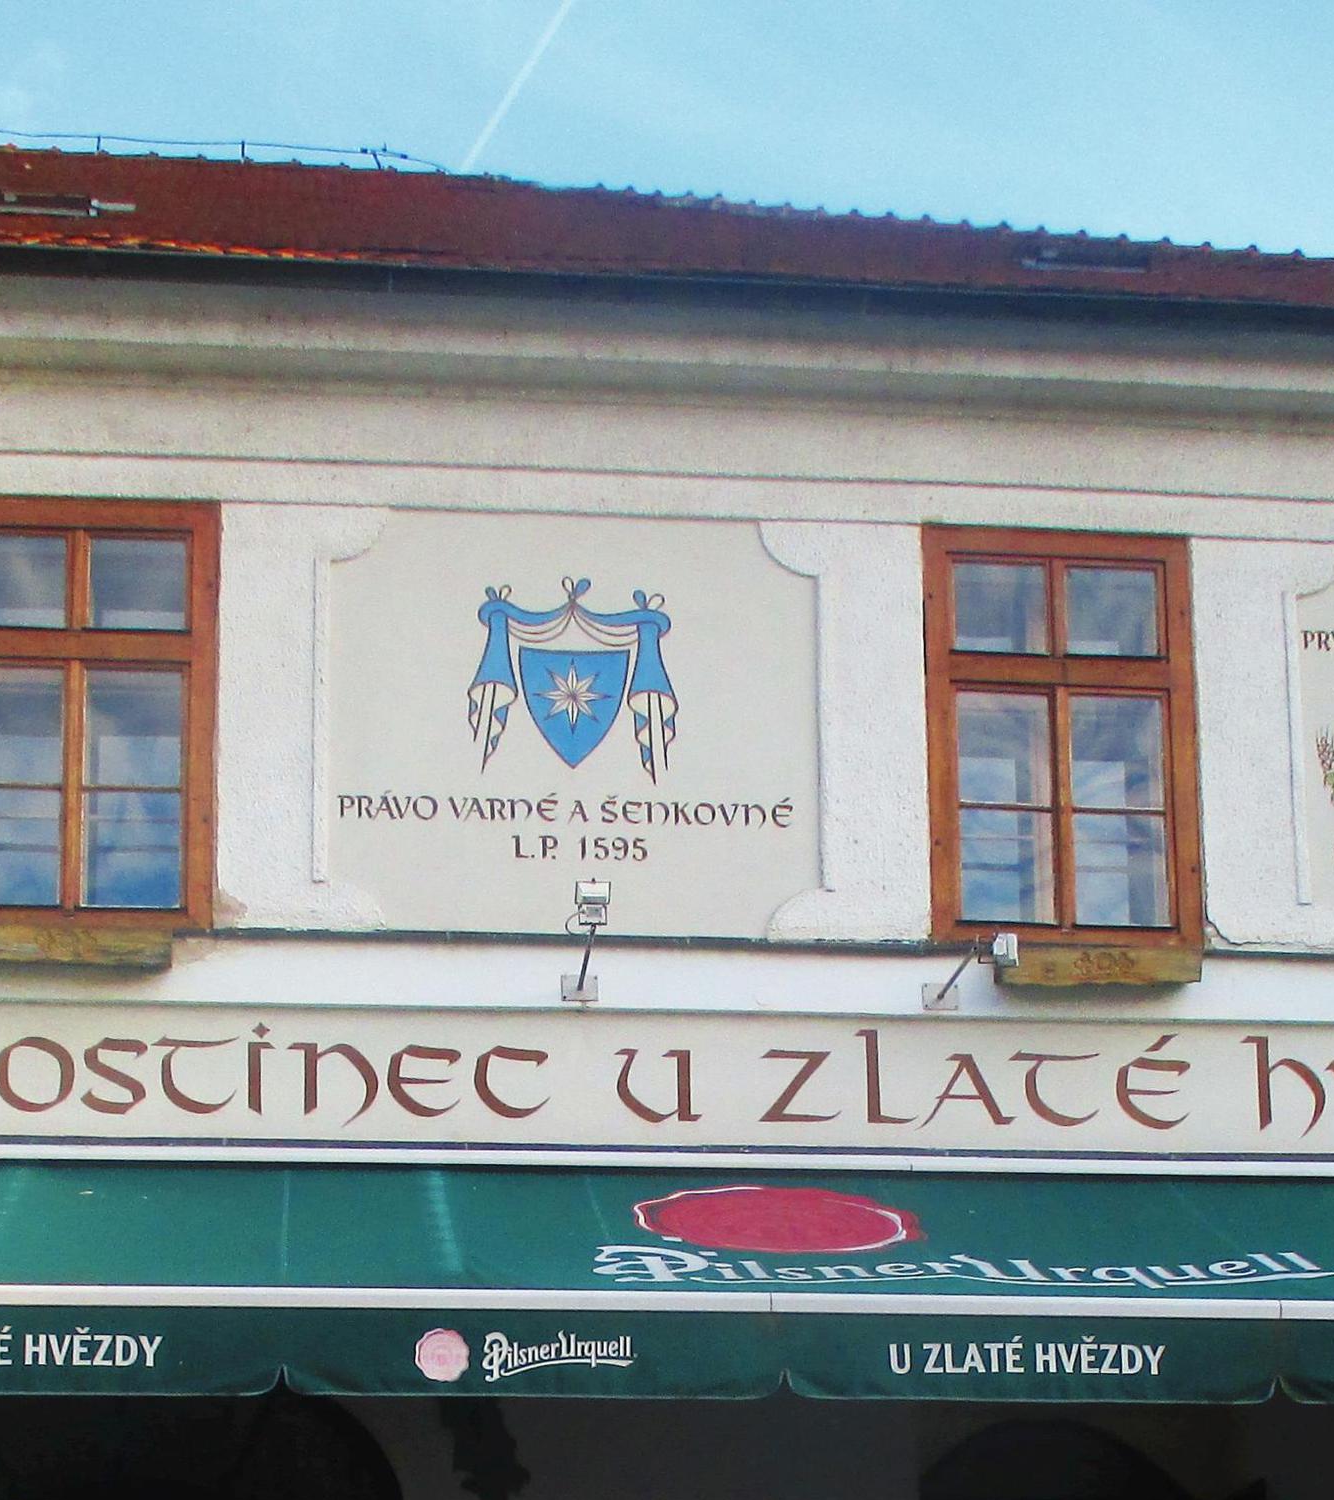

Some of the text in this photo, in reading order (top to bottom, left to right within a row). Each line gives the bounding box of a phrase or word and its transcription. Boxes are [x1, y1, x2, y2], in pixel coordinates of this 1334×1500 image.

[338, 790, 794, 828] PRÁVO VARNÉ A ŠENKOVNÉ
[579, 836, 649, 861] 1595
[615, 1046, 702, 1122] U
[759, 1028, 1190, 1129] ZLATÉ
[593, 1245, 1323, 1289] Pilsner Urquell
[24, 1330, 161, 1367] HVĚZDY
[483, 1330, 633, 1382] Pilsner Urquell
[889, 1336, 1165, 1376] U ZLATÉ HVĚZDY
